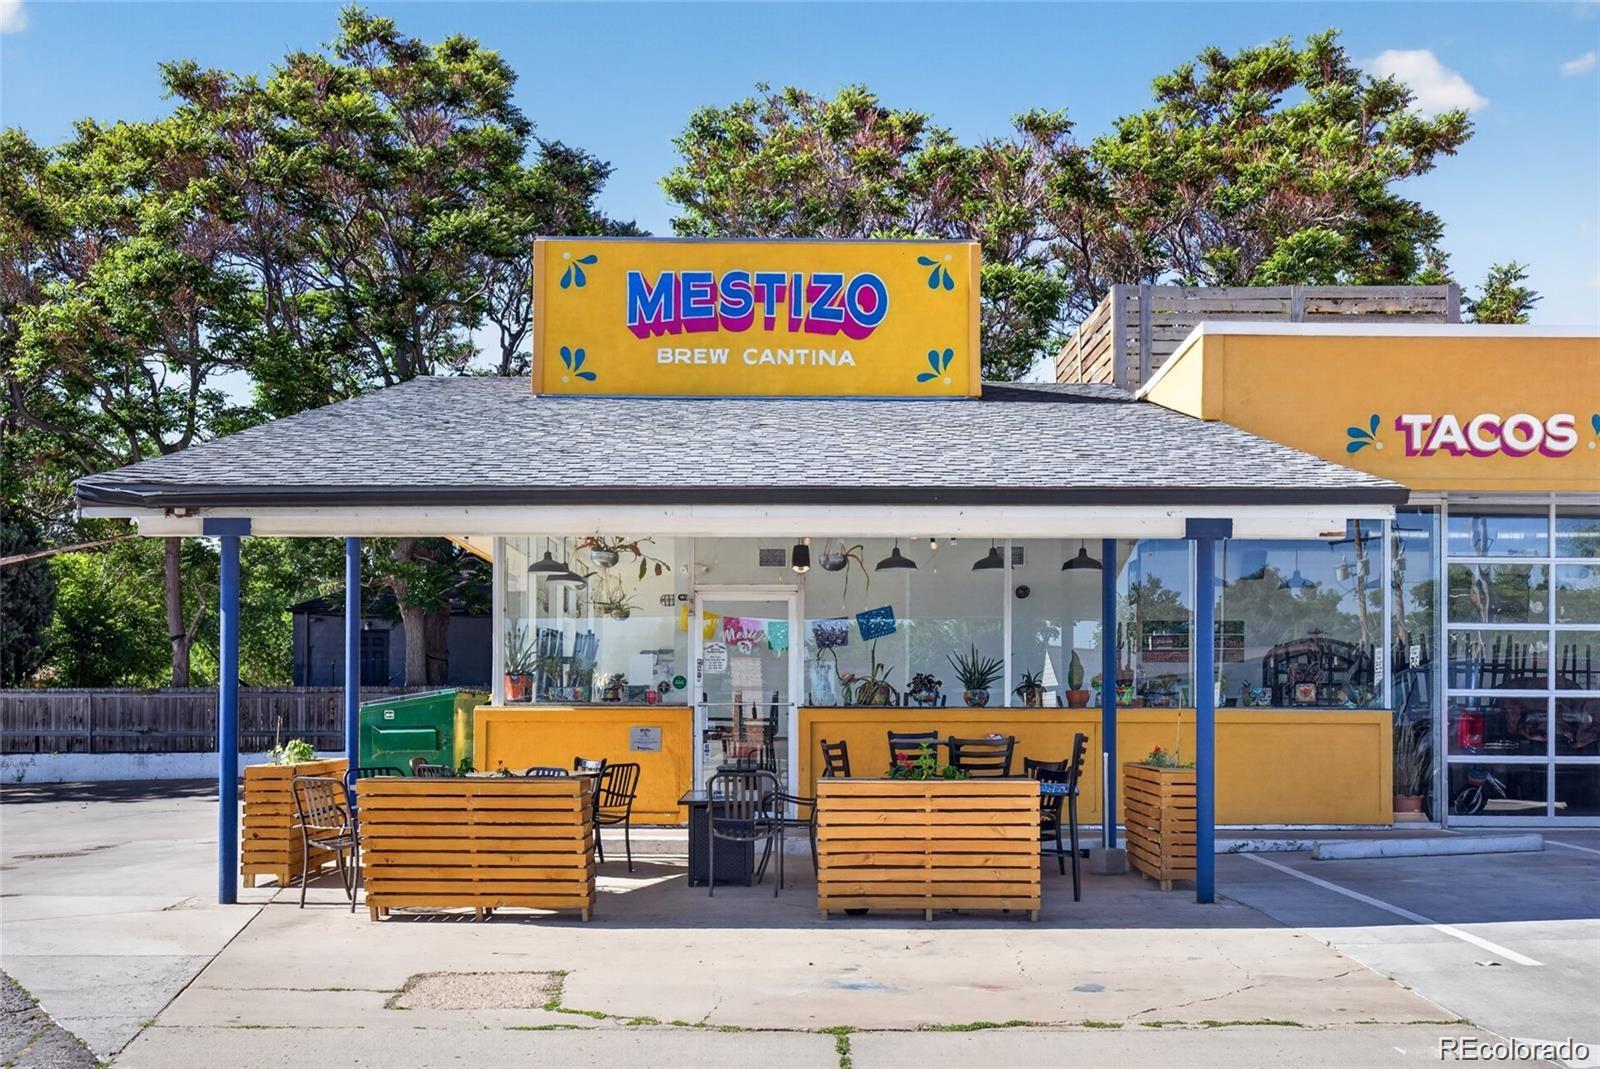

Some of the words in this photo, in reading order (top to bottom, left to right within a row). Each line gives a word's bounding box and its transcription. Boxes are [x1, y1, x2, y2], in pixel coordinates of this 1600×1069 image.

[626, 269, 889, 340] MESTIZO
[656, 348, 729, 366] BREW
[742, 349, 856, 367] CANTINA
[1395, 413, 1578, 457] TACOS
